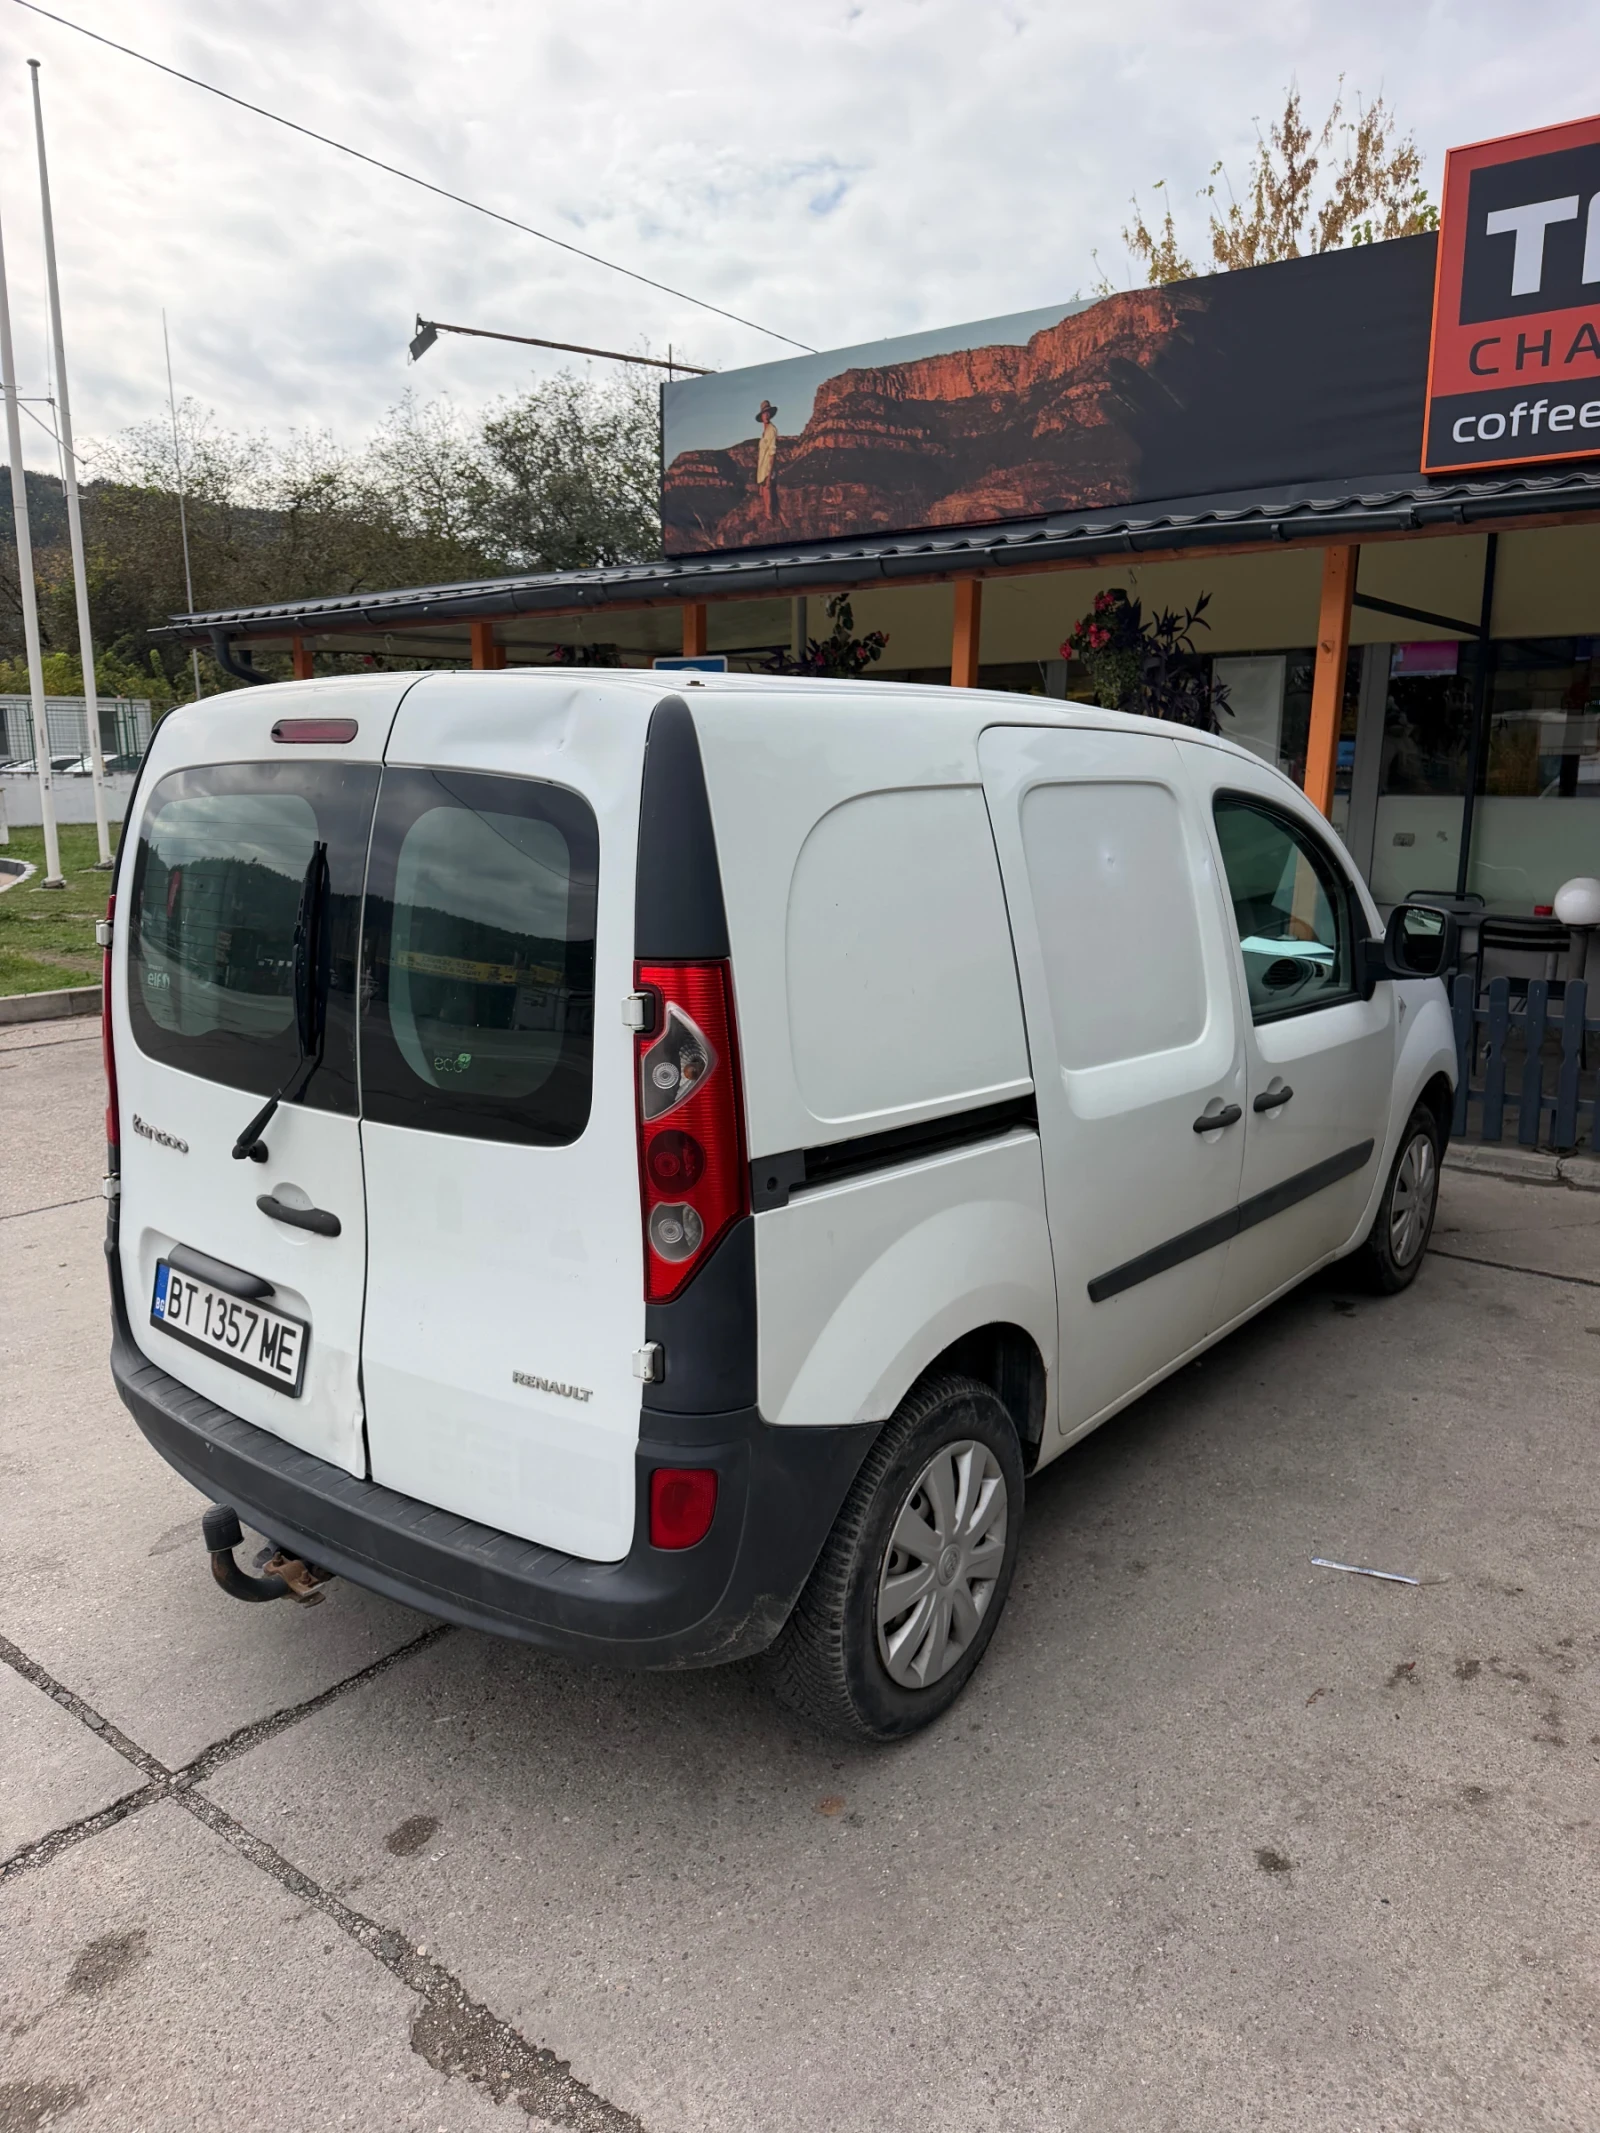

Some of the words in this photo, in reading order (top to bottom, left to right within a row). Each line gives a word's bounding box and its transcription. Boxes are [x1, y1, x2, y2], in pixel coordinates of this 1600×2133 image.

[1469, 323, 1600, 376] CHA
[1452, 399, 1600, 443] coffee
[147, 972, 162, 988] elf
[155, 1297, 165, 1312] BG
[167, 1275, 199, 1327] BT
[203, 1293, 259, 1353] 1357
[258, 1317, 297, 1376] ME
[512, 1369, 594, 1403] RENAULT
